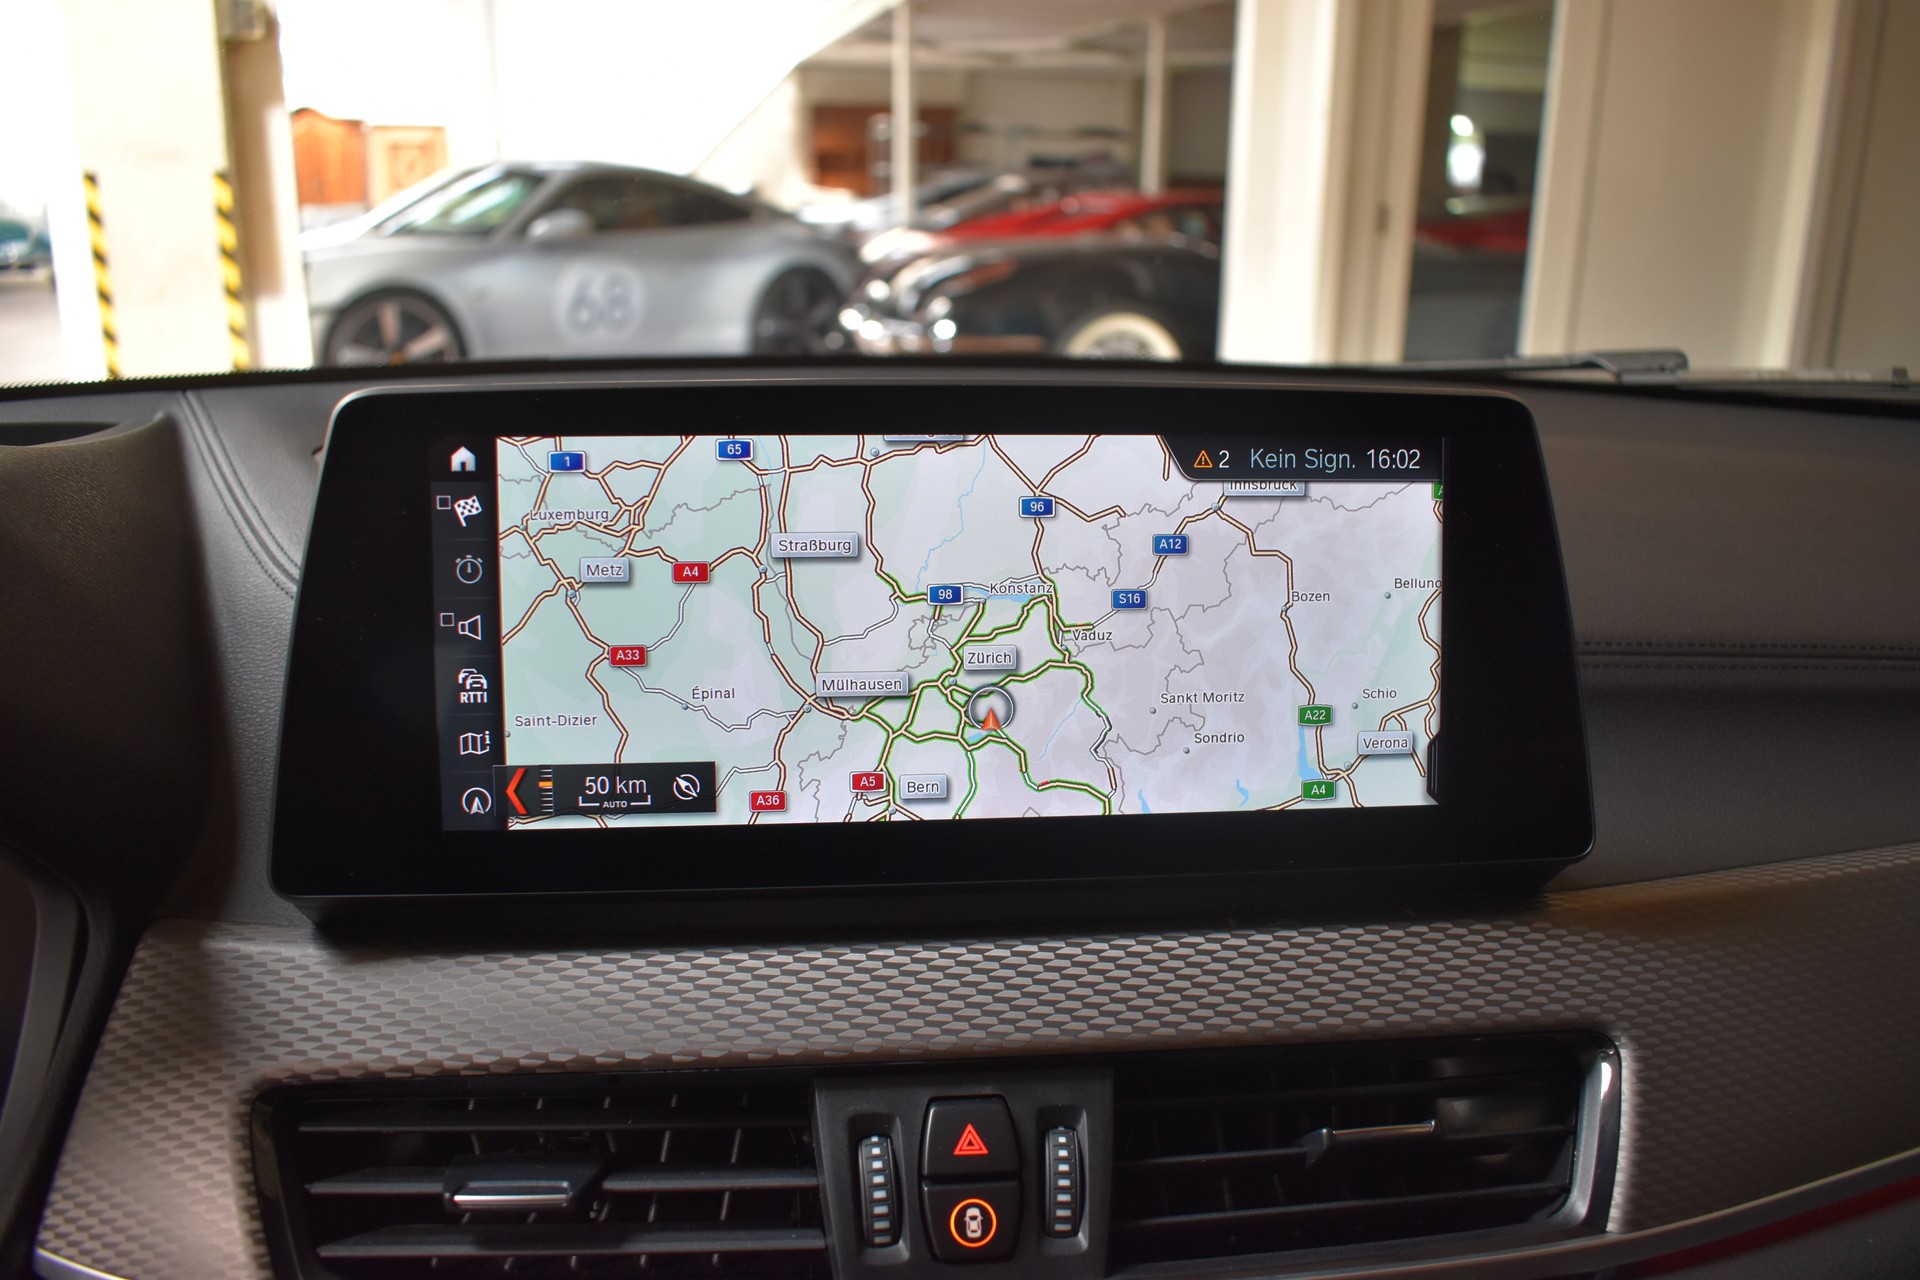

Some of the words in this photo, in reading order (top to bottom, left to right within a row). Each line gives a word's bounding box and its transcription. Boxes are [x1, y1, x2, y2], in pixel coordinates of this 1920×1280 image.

[568, 271, 639, 334] 68
[727, 444, 742, 455] 65
[563, 456, 571, 467] 1
[1218, 450, 1231, 469] 2
[1250, 449, 1297, 469] Kein
[1305, 448, 1356, 473] Sign.
[1366, 449, 1421, 469] 16:02
[1030, 501, 1045, 513] 96
[529, 508, 610, 523] Luxemburg
[778, 538, 852, 553] Straßburg
[1159, 538, 1182, 550] A12
[586, 563, 624, 577] Metz
[682, 566, 699, 577] A4
[989, 582, 1054, 595] Konstanz
[1394, 577, 1443, 590] Belluno
[937, 589, 953, 600] 98
[1119, 593, 1141, 604] S16
[1291, 590, 1331, 603] Bozen
[1072, 629, 1113, 642] Vaduz
[616, 649, 640, 661] A33
[967, 651, 1013, 665] Zürich
[821, 677, 903, 692] Mülhausen
[459, 691, 488, 704] RTTI
[691, 685, 736, 701] Épinal
[1160, 691, 1198, 704] Sankt
[1202, 691, 1245, 703] Moritz
[1362, 687, 1398, 700] Schio
[514, 714, 598, 727] Saint-Dizier
[1304, 709, 1327, 721] A22
[1194, 731, 1245, 744] Sondrio
[1363, 737, 1409, 750] Verona
[584, 776, 610, 796] 50
[616, 775, 648, 795] km
[859, 776, 876, 788] A5
[907, 780, 940, 794] Bern
[1310, 784, 1327, 796] A4
[602, 799, 628, 809] AUTO
[756, 794, 780, 806] A36
